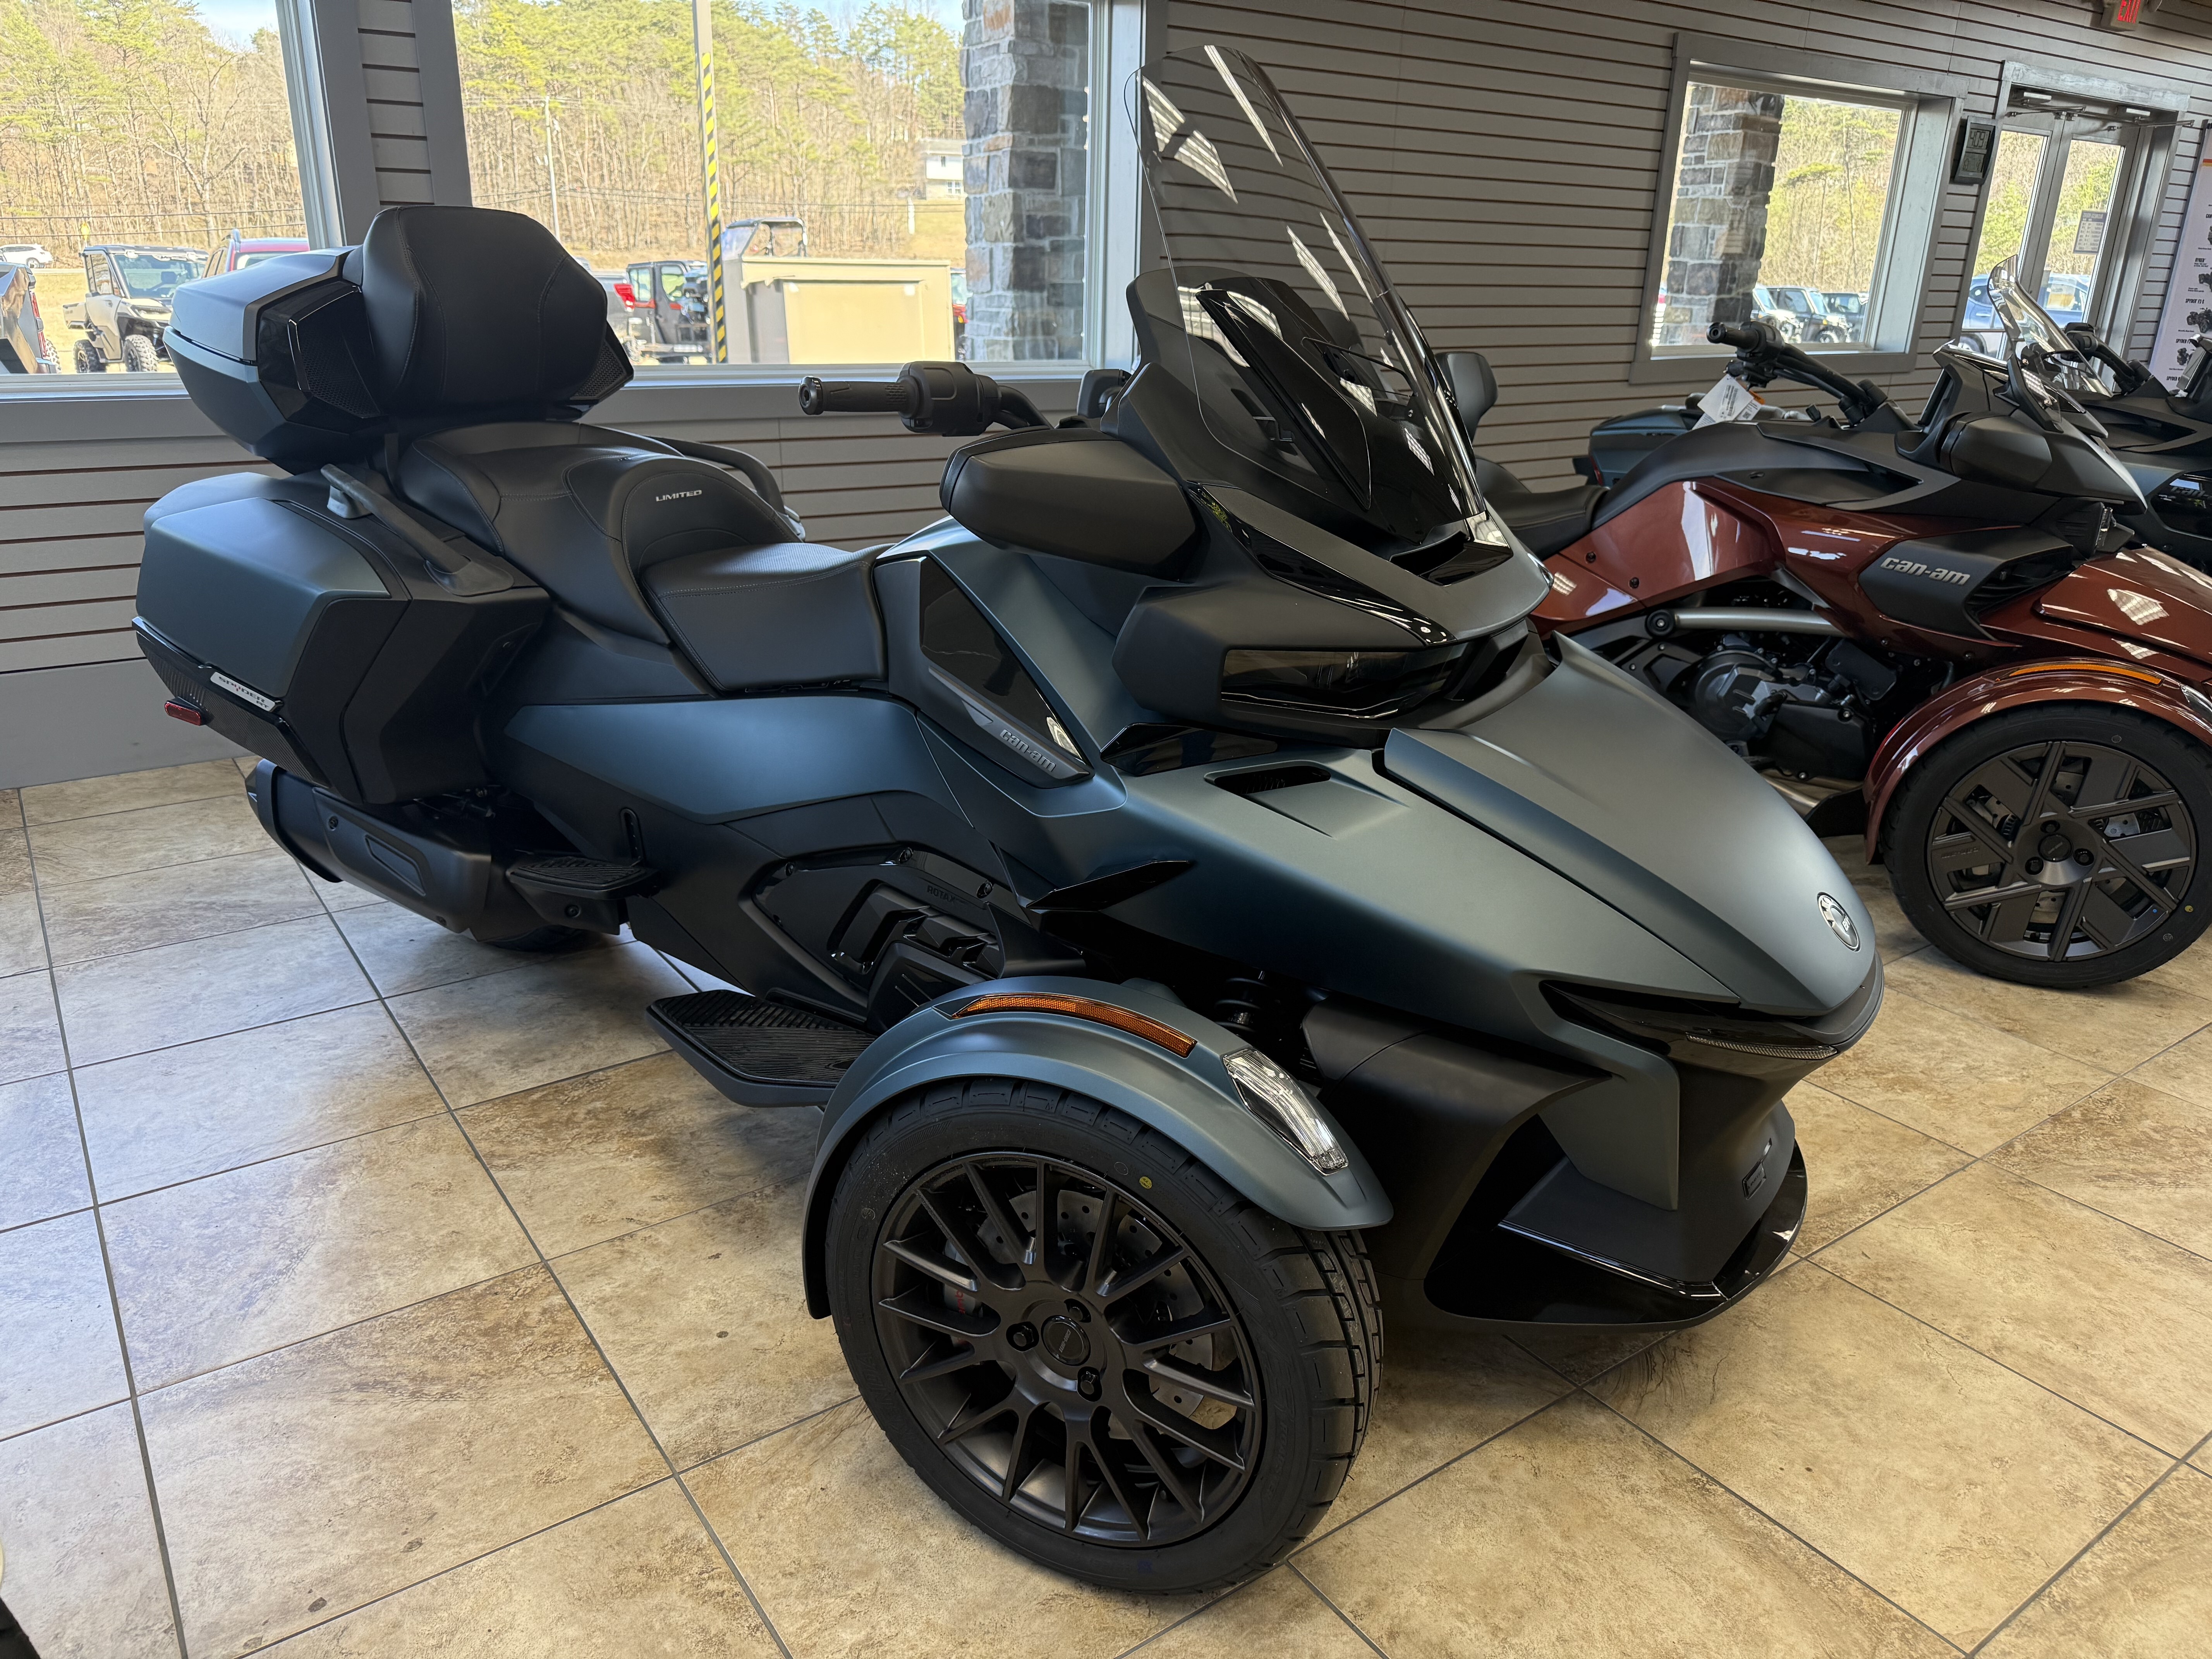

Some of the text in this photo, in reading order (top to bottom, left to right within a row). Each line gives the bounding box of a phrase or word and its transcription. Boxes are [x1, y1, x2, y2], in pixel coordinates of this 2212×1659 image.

[656, 489, 702, 501] LIMITED
[1881, 557, 1970, 585] can-am
[1000, 729, 1056, 772] can-am
[927, 885, 956, 903] ROTAX
